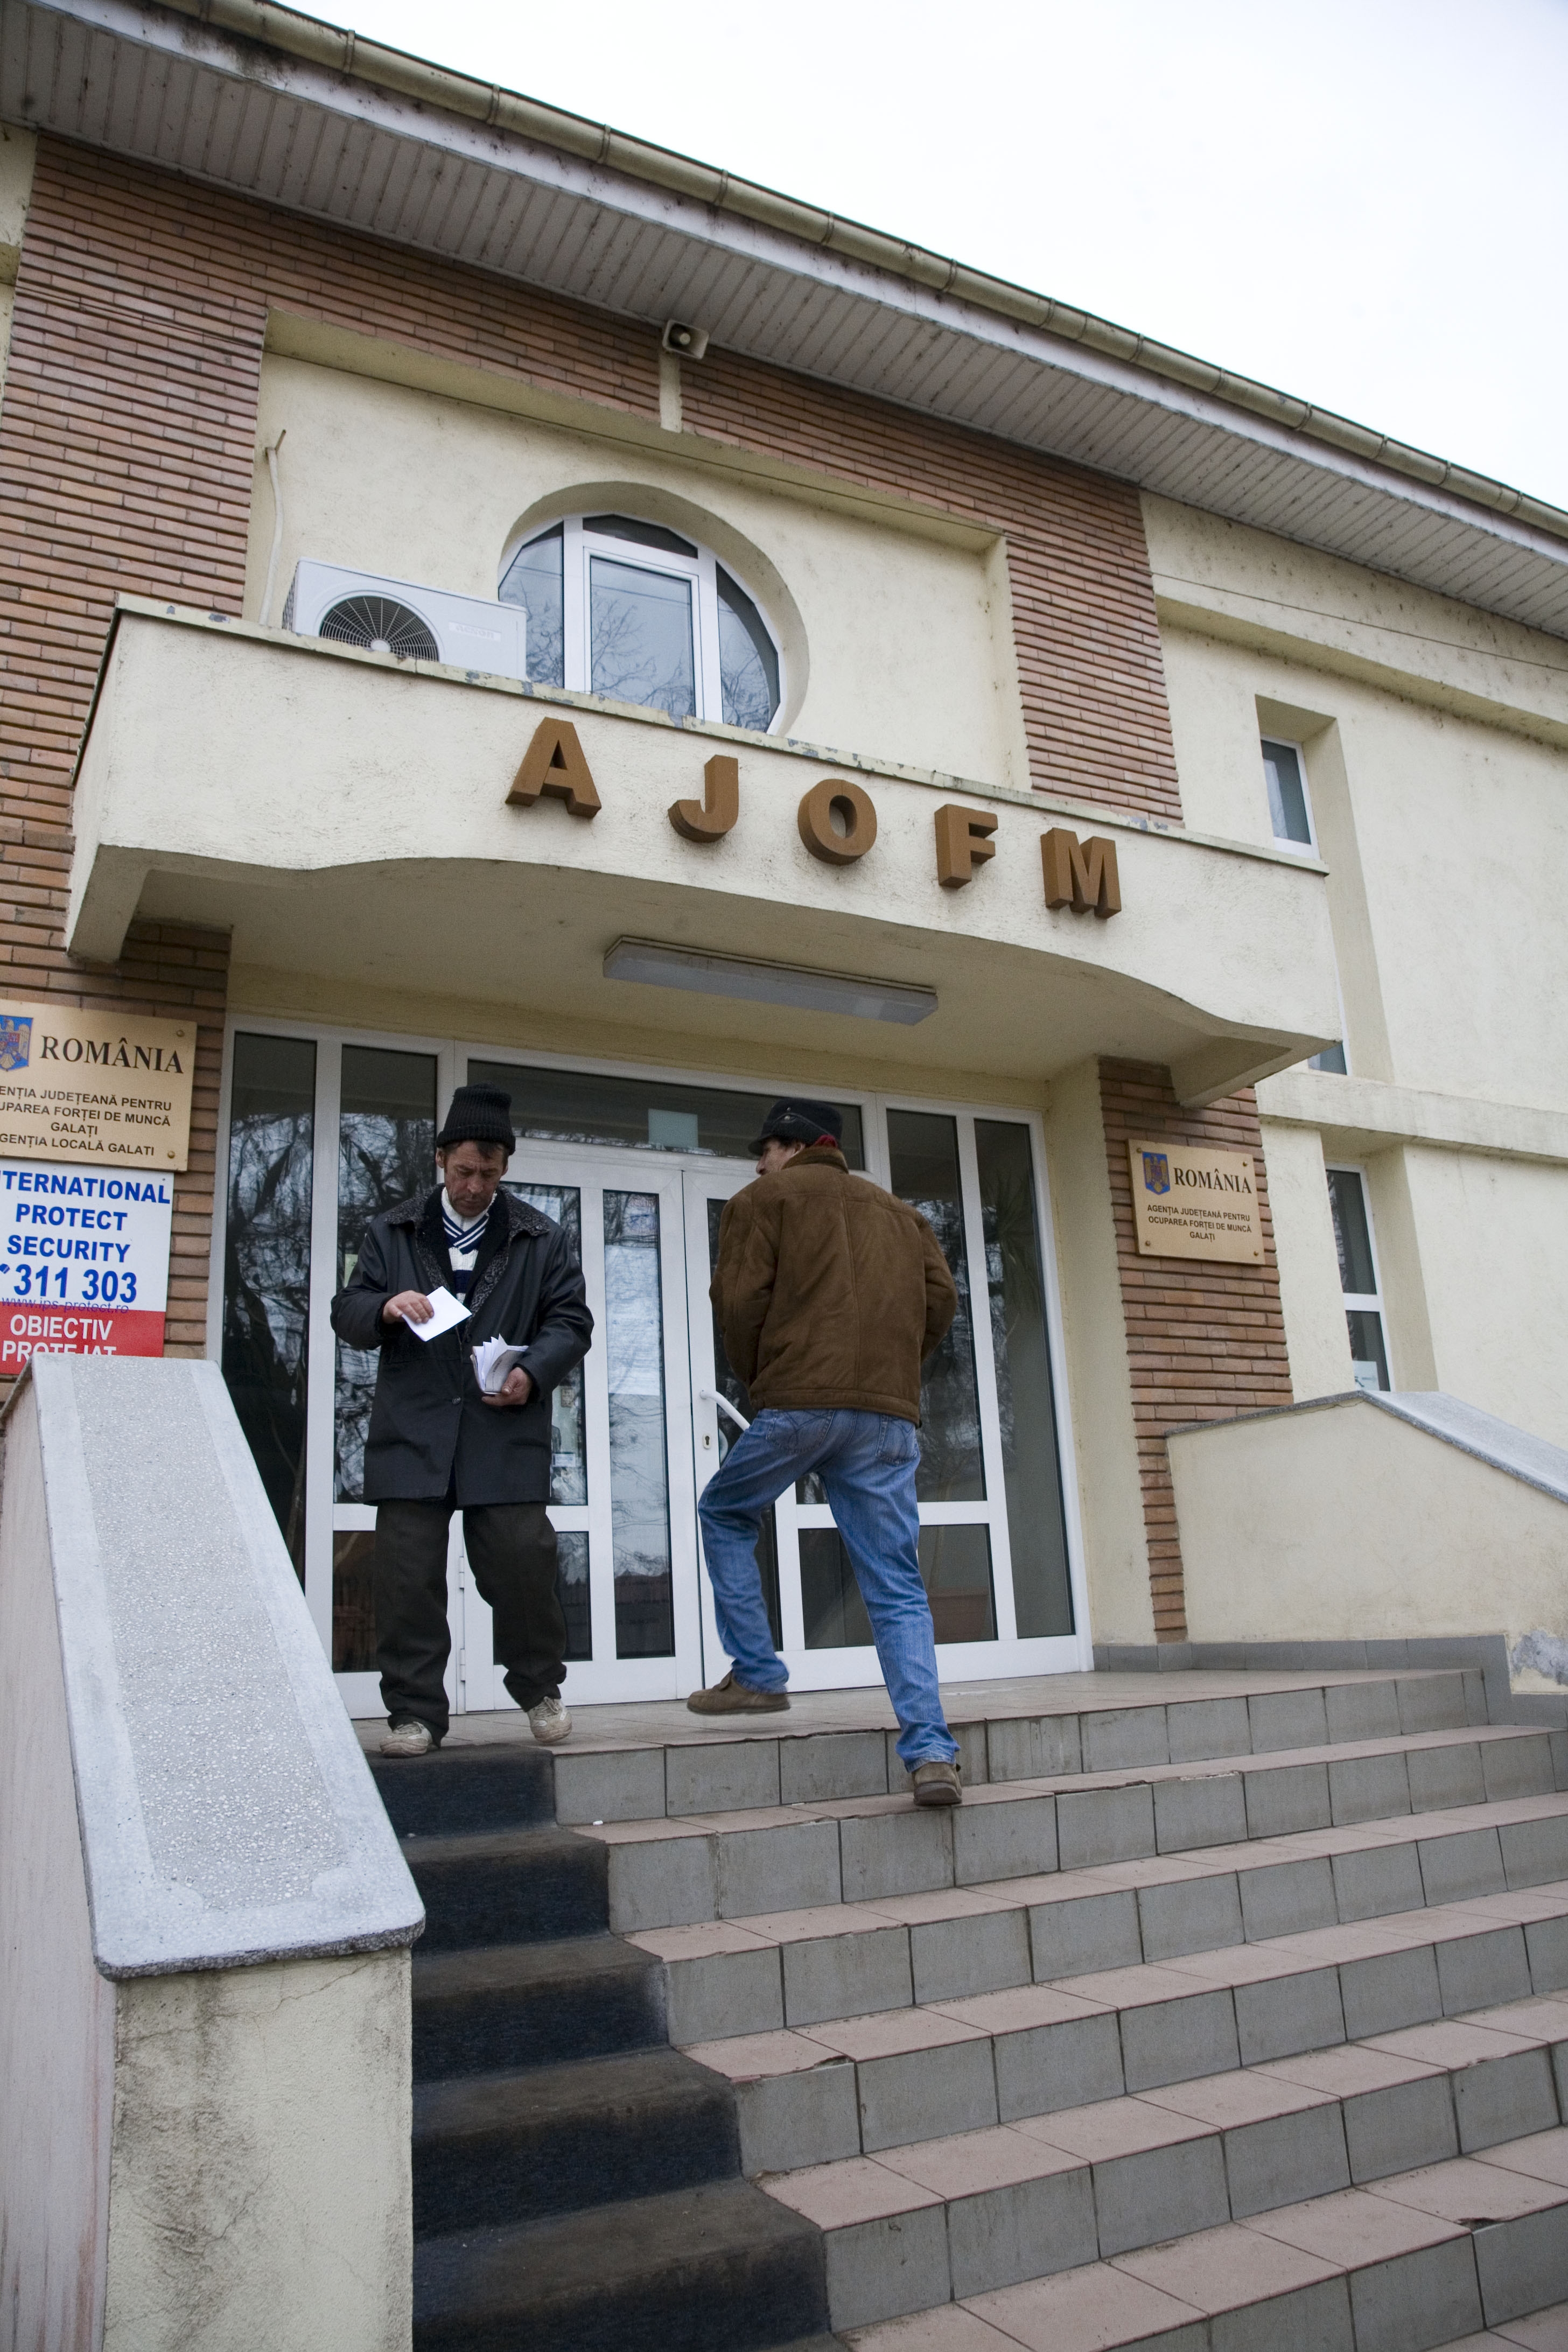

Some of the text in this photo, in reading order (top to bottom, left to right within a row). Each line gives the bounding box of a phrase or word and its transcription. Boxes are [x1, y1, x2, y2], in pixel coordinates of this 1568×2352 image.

[39, 1035, 184, 1074] ROMÂNIA
[40, 1090, 117, 1106] JUDEȚEANĂ
[122, 1097, 172, 1111] PENTRU
[54, 1107, 100, 1121] FORȚEI
[104, 1111, 121, 1121] DE
[125, 1114, 170, 1126] MUNCĂ
[51, 1122, 97, 1137] GALAȚI
[52, 1138, 104, 1151] LOCALĂ
[0, 1171, 170, 1204] TERNATIONAL
[1174, 1168, 1251, 1194] ROMÂNIA
[16, 1203, 128, 1231] PROTECT
[1147, 1205, 1250, 1221] AGENȚIA JUDEȚEANĂ PENTRU
[1149, 1216, 1188, 1226] OCUPAREA
[1190, 1221, 1214, 1230] FORȚEI
[1228, 1224, 1251, 1233] MUNCĂ
[1190, 1232, 1215, 1242] GALAȚI
[7, 1235, 131, 1263] SECURITY
[14, 1264, 137, 1303] 311 303
[2, 1298, 129, 1314] www.ips-protect.ro
[10, 1314, 113, 1340] OBIECTIV
